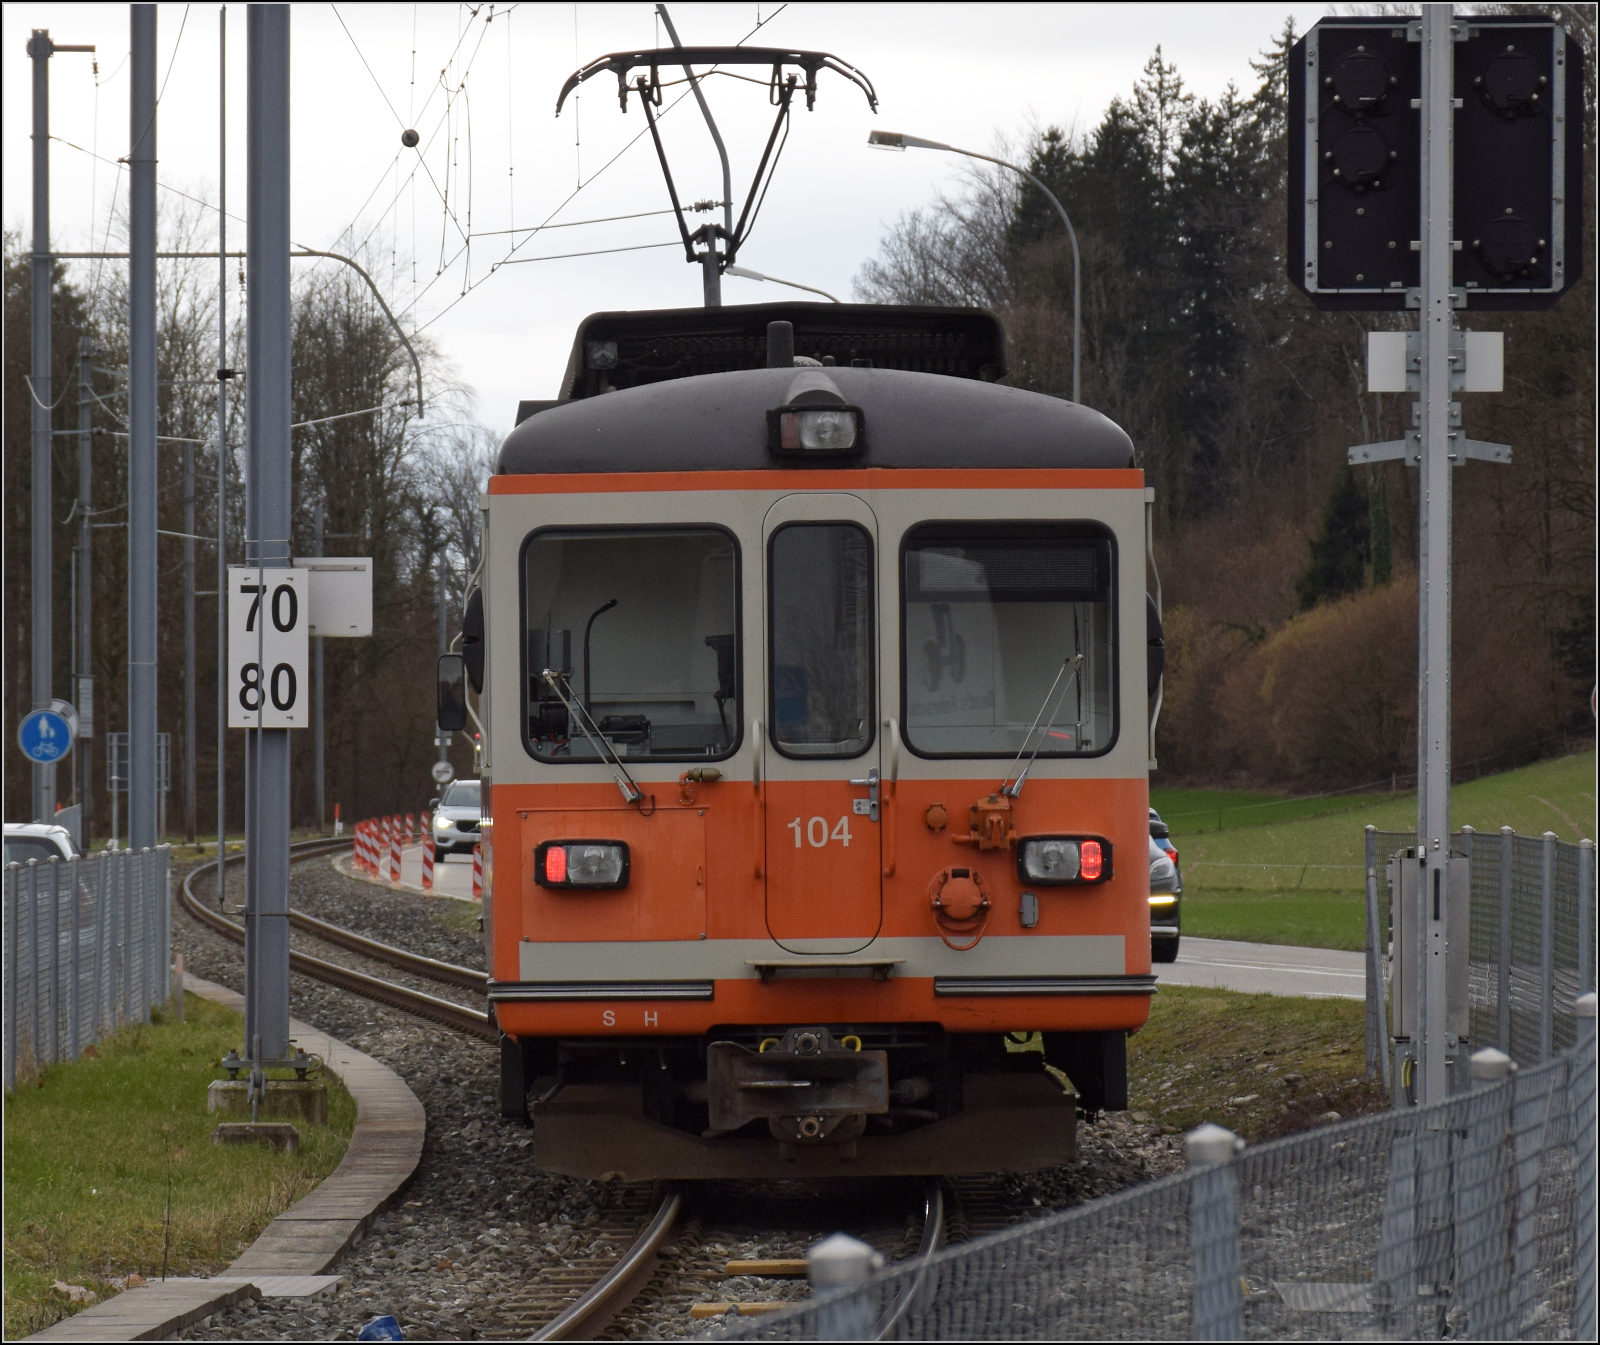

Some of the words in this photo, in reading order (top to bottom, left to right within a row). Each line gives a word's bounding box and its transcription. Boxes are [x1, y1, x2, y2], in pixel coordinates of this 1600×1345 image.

[240, 584, 298, 633] 70
[239, 662, 297, 711] 80
[787, 815, 853, 849] 104
[602, 1010, 616, 1027] S
[644, 1010, 659, 1028] H
